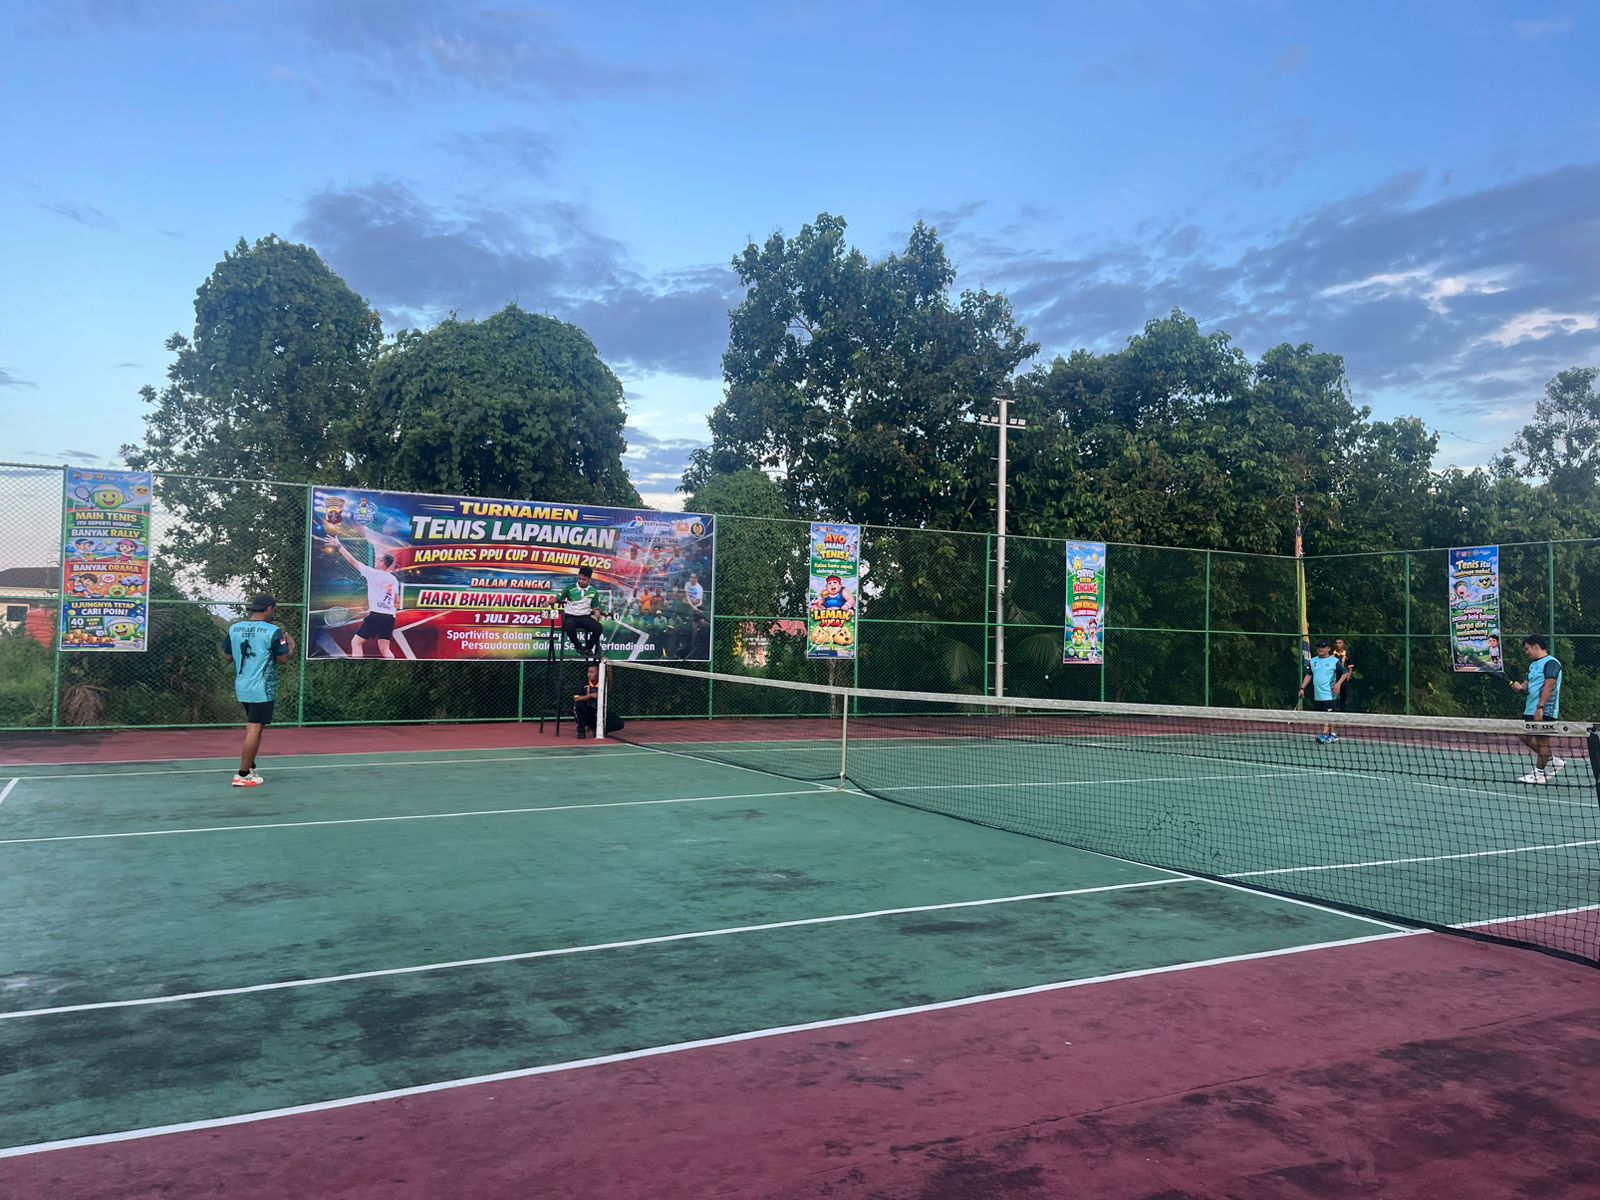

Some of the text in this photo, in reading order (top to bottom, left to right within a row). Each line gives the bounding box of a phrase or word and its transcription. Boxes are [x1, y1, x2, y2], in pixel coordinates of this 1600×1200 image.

[75, 511, 138, 522] MAIN TENIS
[459, 501, 579, 521] TURNAMEN
[71, 528, 140, 538] BANYAK RALLY
[411, 515, 616, 550] TENIS LAPANGAN
[825, 533, 847, 545] AYO
[825, 542, 844, 550] MAIN
[414, 548, 612, 570] KAPOLRES PPU CUP II TAHUN 2026
[820, 549, 850, 560] TENIS!
[108, 564, 139, 573] DRAMA
[1455, 559, 1491, 570] Tenis itu
[1076, 568, 1095, 579] SERVIS
[470, 577, 551, 590] DALAM RANGKA
[419, 591, 458, 606] HARI
[103, 608, 128, 616] POIN!
[813, 609, 851, 621] LEMAK
[70, 617, 84, 626] 40
[474, 613, 542, 624] 1 JULI 2026
[1455, 622, 1475, 631] harga
[1474, 621, 1487, 629] diri
[446, 629, 500, 640] Sportivitas
[502, 630, 533, 640] dalam
[461, 640, 530, 650] Persaudaraan
